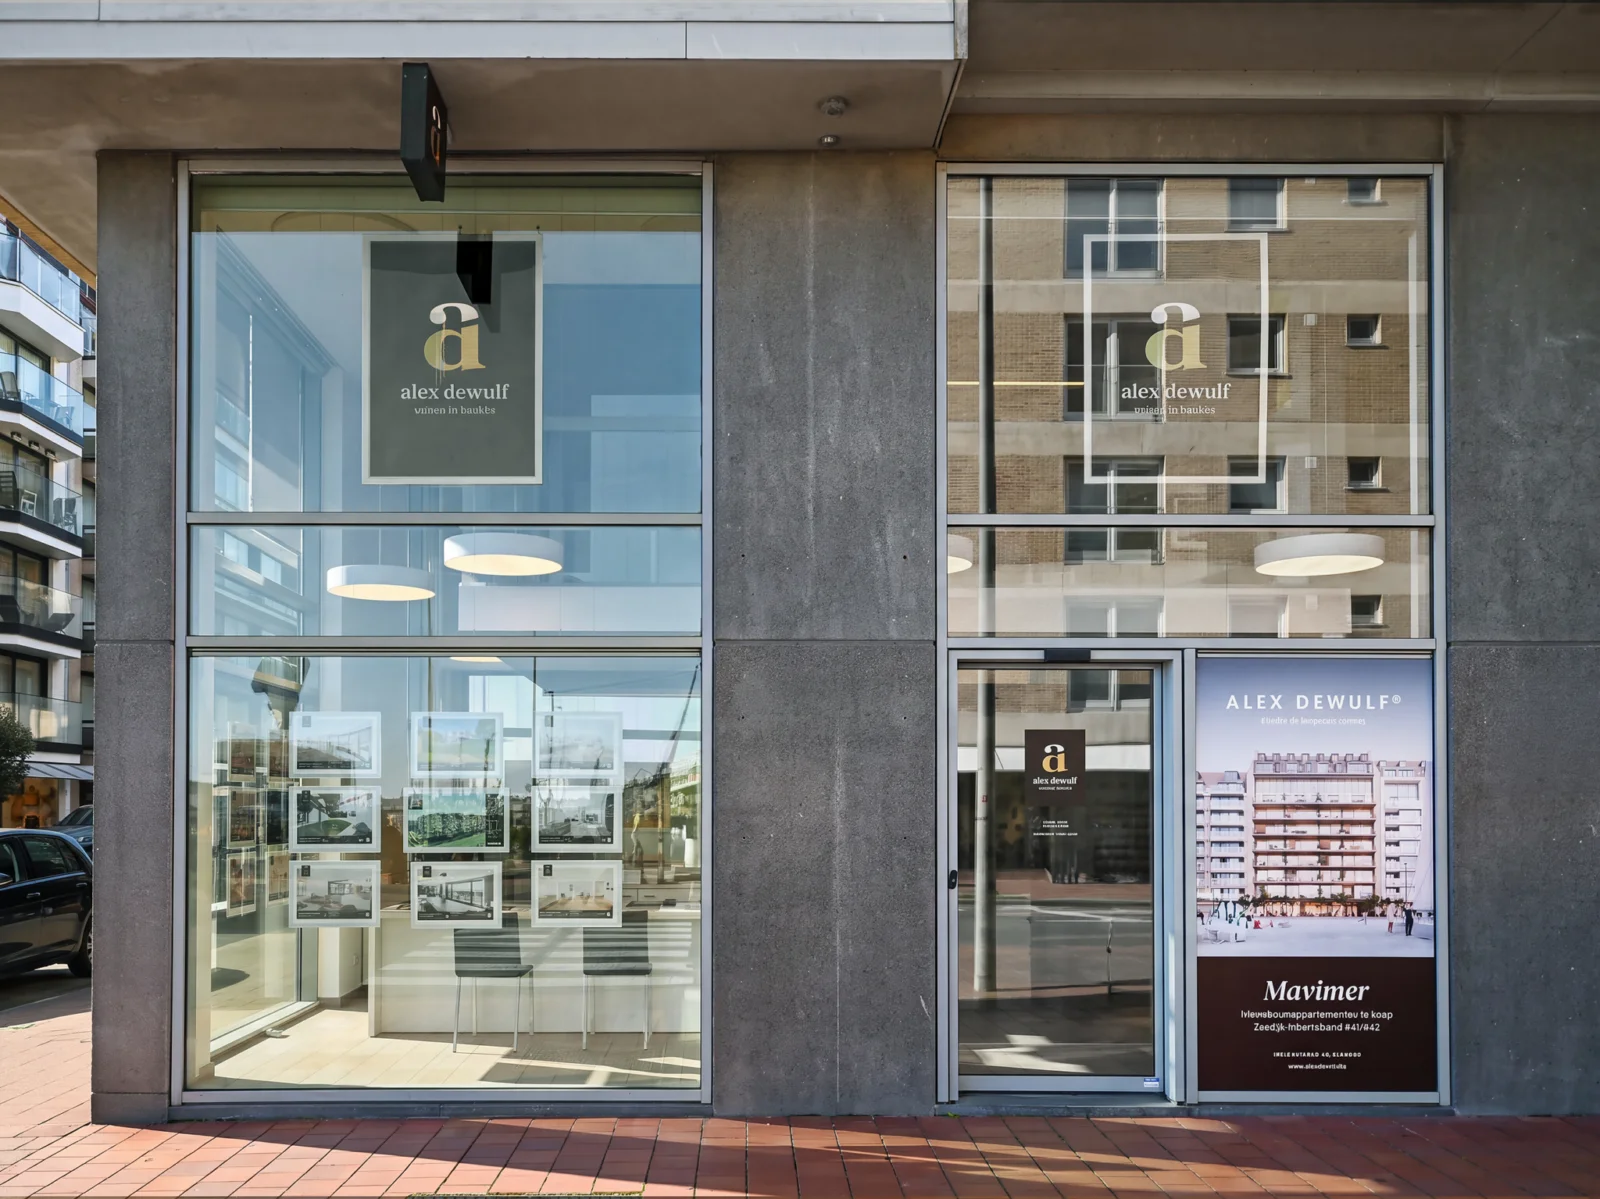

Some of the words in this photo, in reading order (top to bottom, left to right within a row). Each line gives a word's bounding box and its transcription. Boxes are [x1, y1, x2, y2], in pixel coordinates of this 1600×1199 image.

[400, 383, 440, 400] alex
[443, 383, 511, 400] dewulf
[1121, 382, 1160, 399] alex
[1164, 382, 1232, 399] dewulf
[448, 405, 459, 415] in
[1168, 405, 1179, 415] in
[1225, 694, 1283, 710] ALEX
[1032, 776, 1049, 785] alex
[1050, 776, 1078, 785] dewulf
[1263, 979, 1371, 1001] Mavimer
[1360, 1010, 1370, 1020] te
[1371, 1009, 1394, 1021] koap
